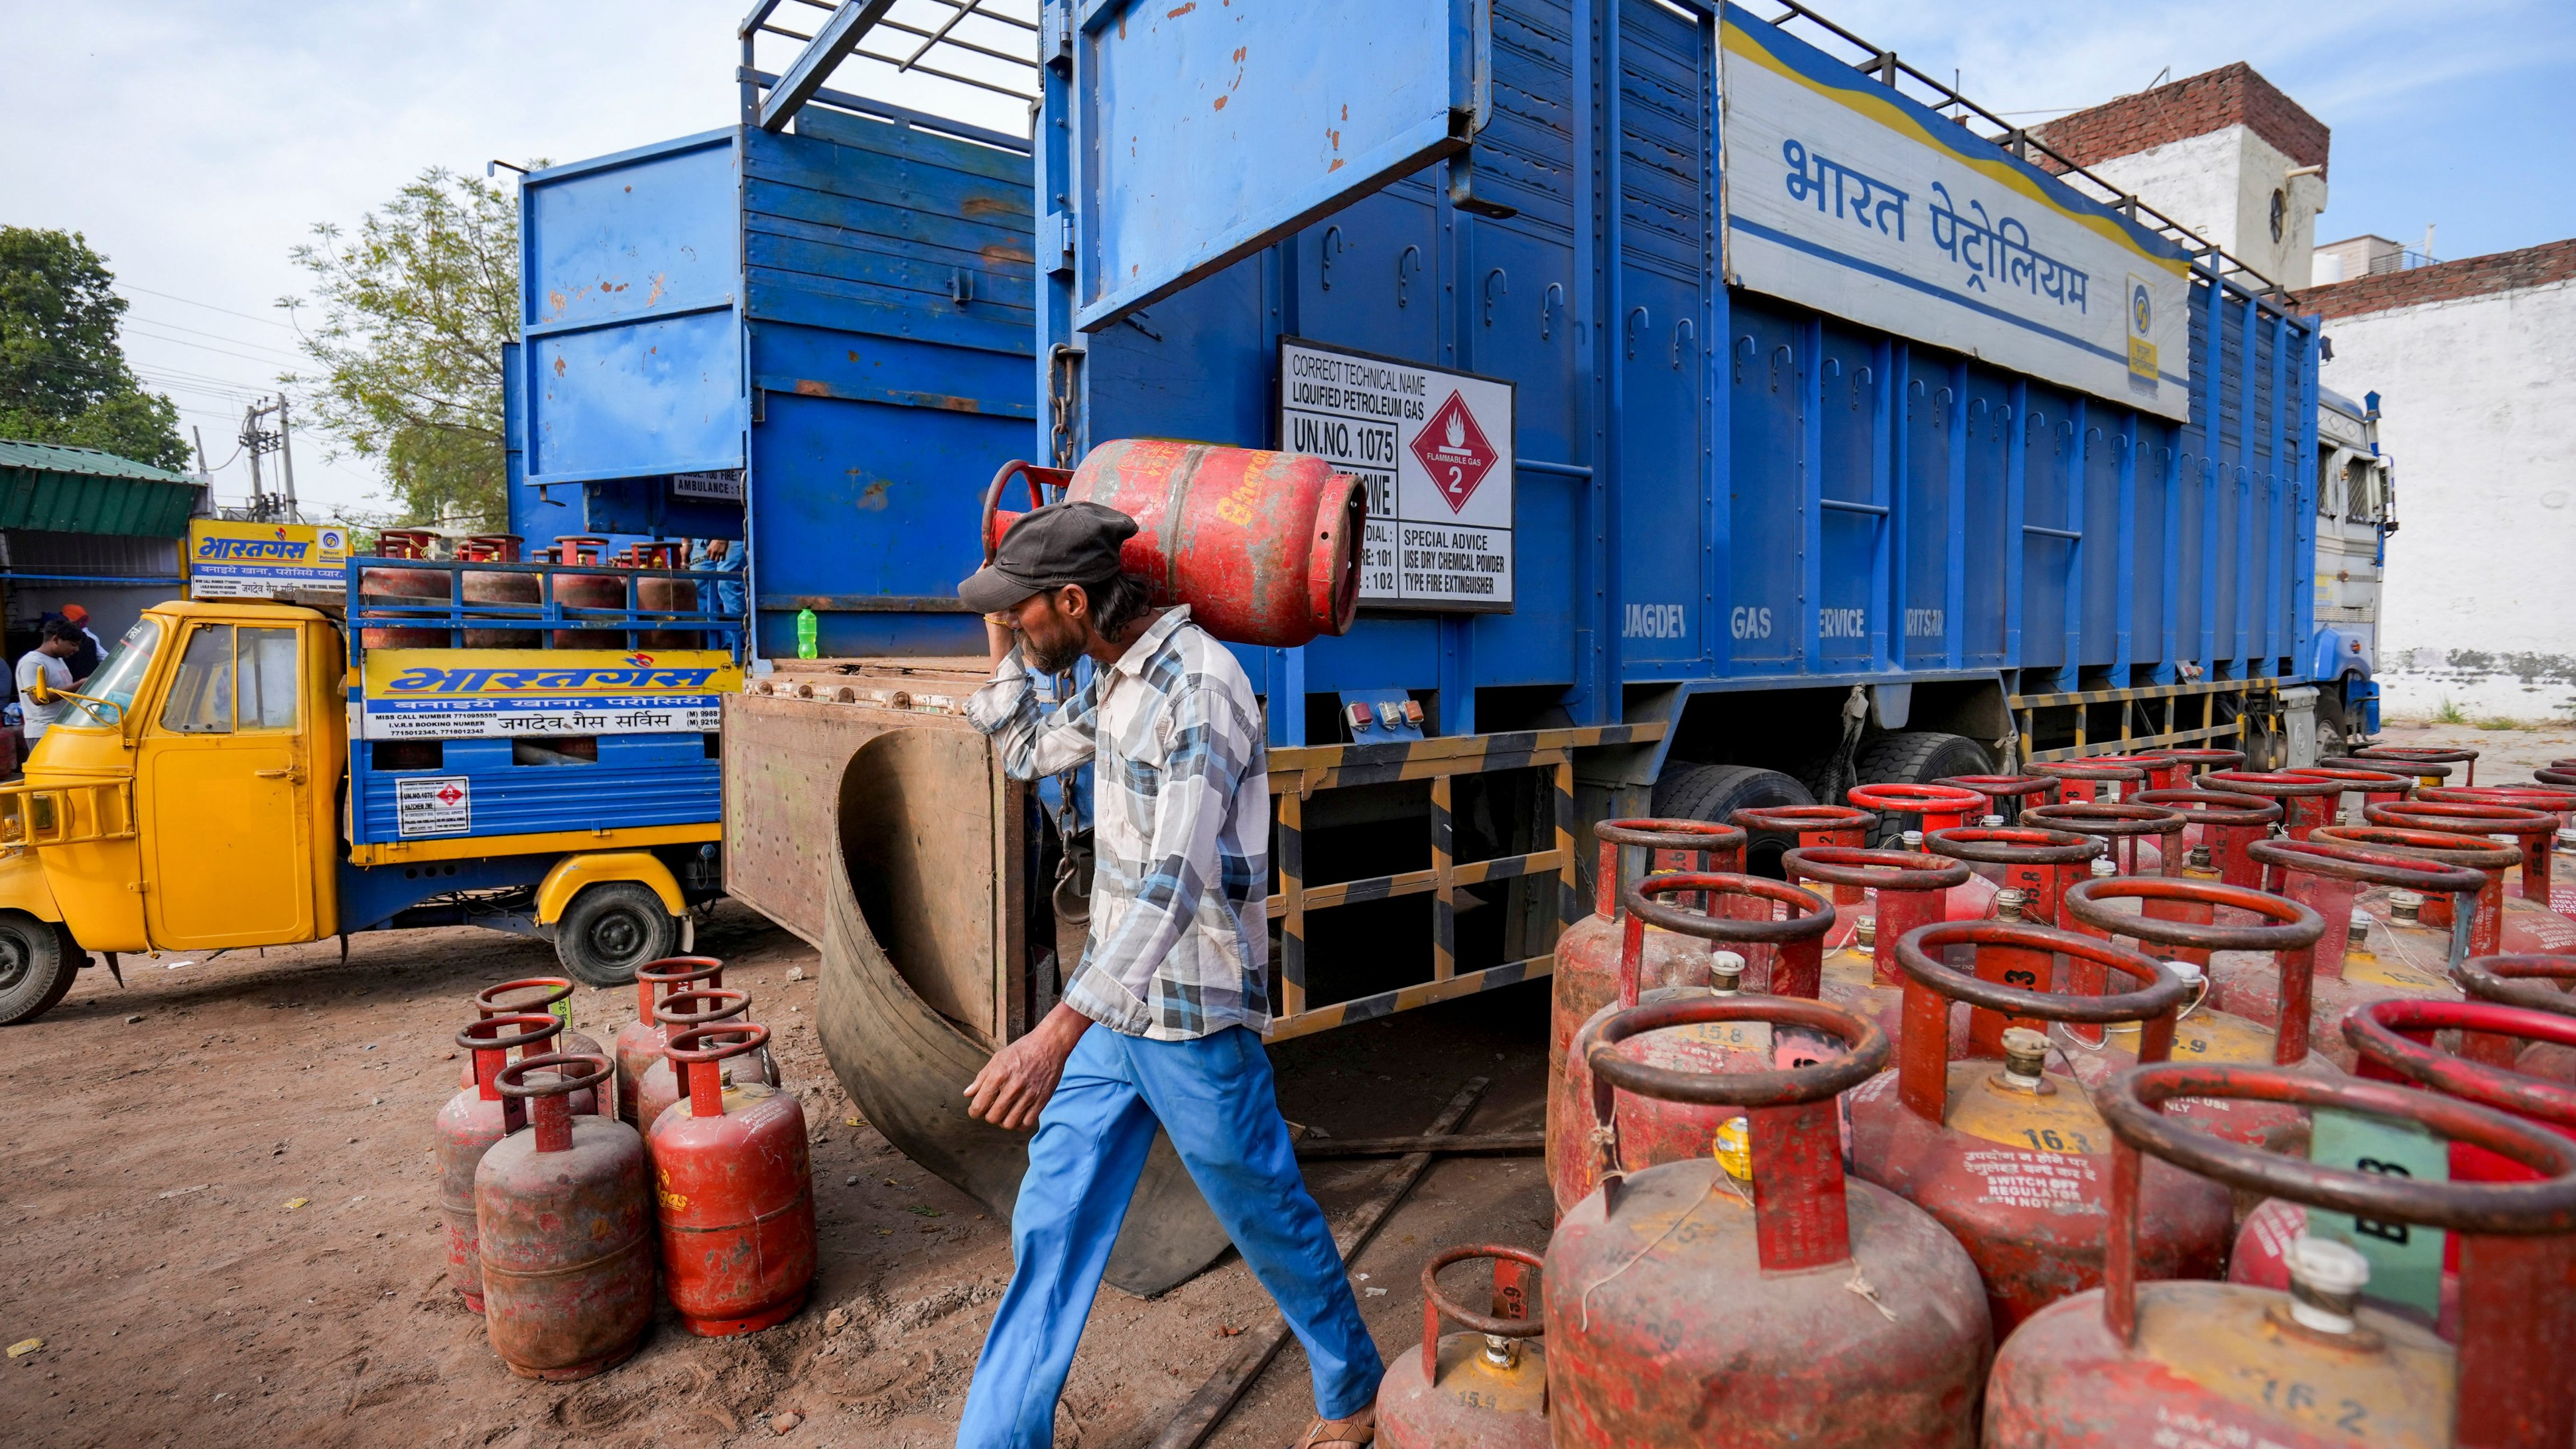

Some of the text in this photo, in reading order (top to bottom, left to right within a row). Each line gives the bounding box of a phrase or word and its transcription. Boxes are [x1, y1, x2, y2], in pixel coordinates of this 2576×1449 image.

[1782, 139, 2089, 315] भारत पेट्रोलियम
[1293, 353, 1426, 397] CORRECT TECHNICAL NAME
[1293, 381, 1425, 421] LIQUIFIED PETROLEUM GAS
[1294, 418, 1393, 463] UN.NO. 1075
[1427, 452, 1482, 467] FLAMMABLE GAS
[678, 479, 729, 494] AMBULANCE
[1449, 466, 1463, 493] 2
[1366, 525, 1387, 542] DIAL
[1404, 529, 1488, 551] SPECIAL ADVICE
[1361, 547, 1392, 567] RE: 101
[1404, 549, 1505, 574] USE DRY CHEMICAL POWDER
[200, 565, 237, 574] बनाइये
[241, 582, 264, 596] जगदेव
[1373, 572, 1393, 590] 102
[1405, 572, 1494, 595] TYPE FIRE EXTINGUISHER
[1731, 606, 1772, 639] GAS
[1819, 609, 1865, 638] ERVICE
[1905, 609, 1945, 637] RITSAR
[497, 710, 673, 731] जगदेव गैस सर्विस
[686, 710, 698, 719] (M)
[1695, 1023, 1744, 1042] 15.8
[2165, 1100, 2191, 1113] NLY
[2203, 1098, 2230, 1111] USE
[2022, 1129, 2094, 1153] 16.3
[1987, 1175, 2079, 1190] SWITCH OFF
[1988, 1186, 2081, 1202] REGULATOR
[2019, 1197, 2051, 1209] NOT
